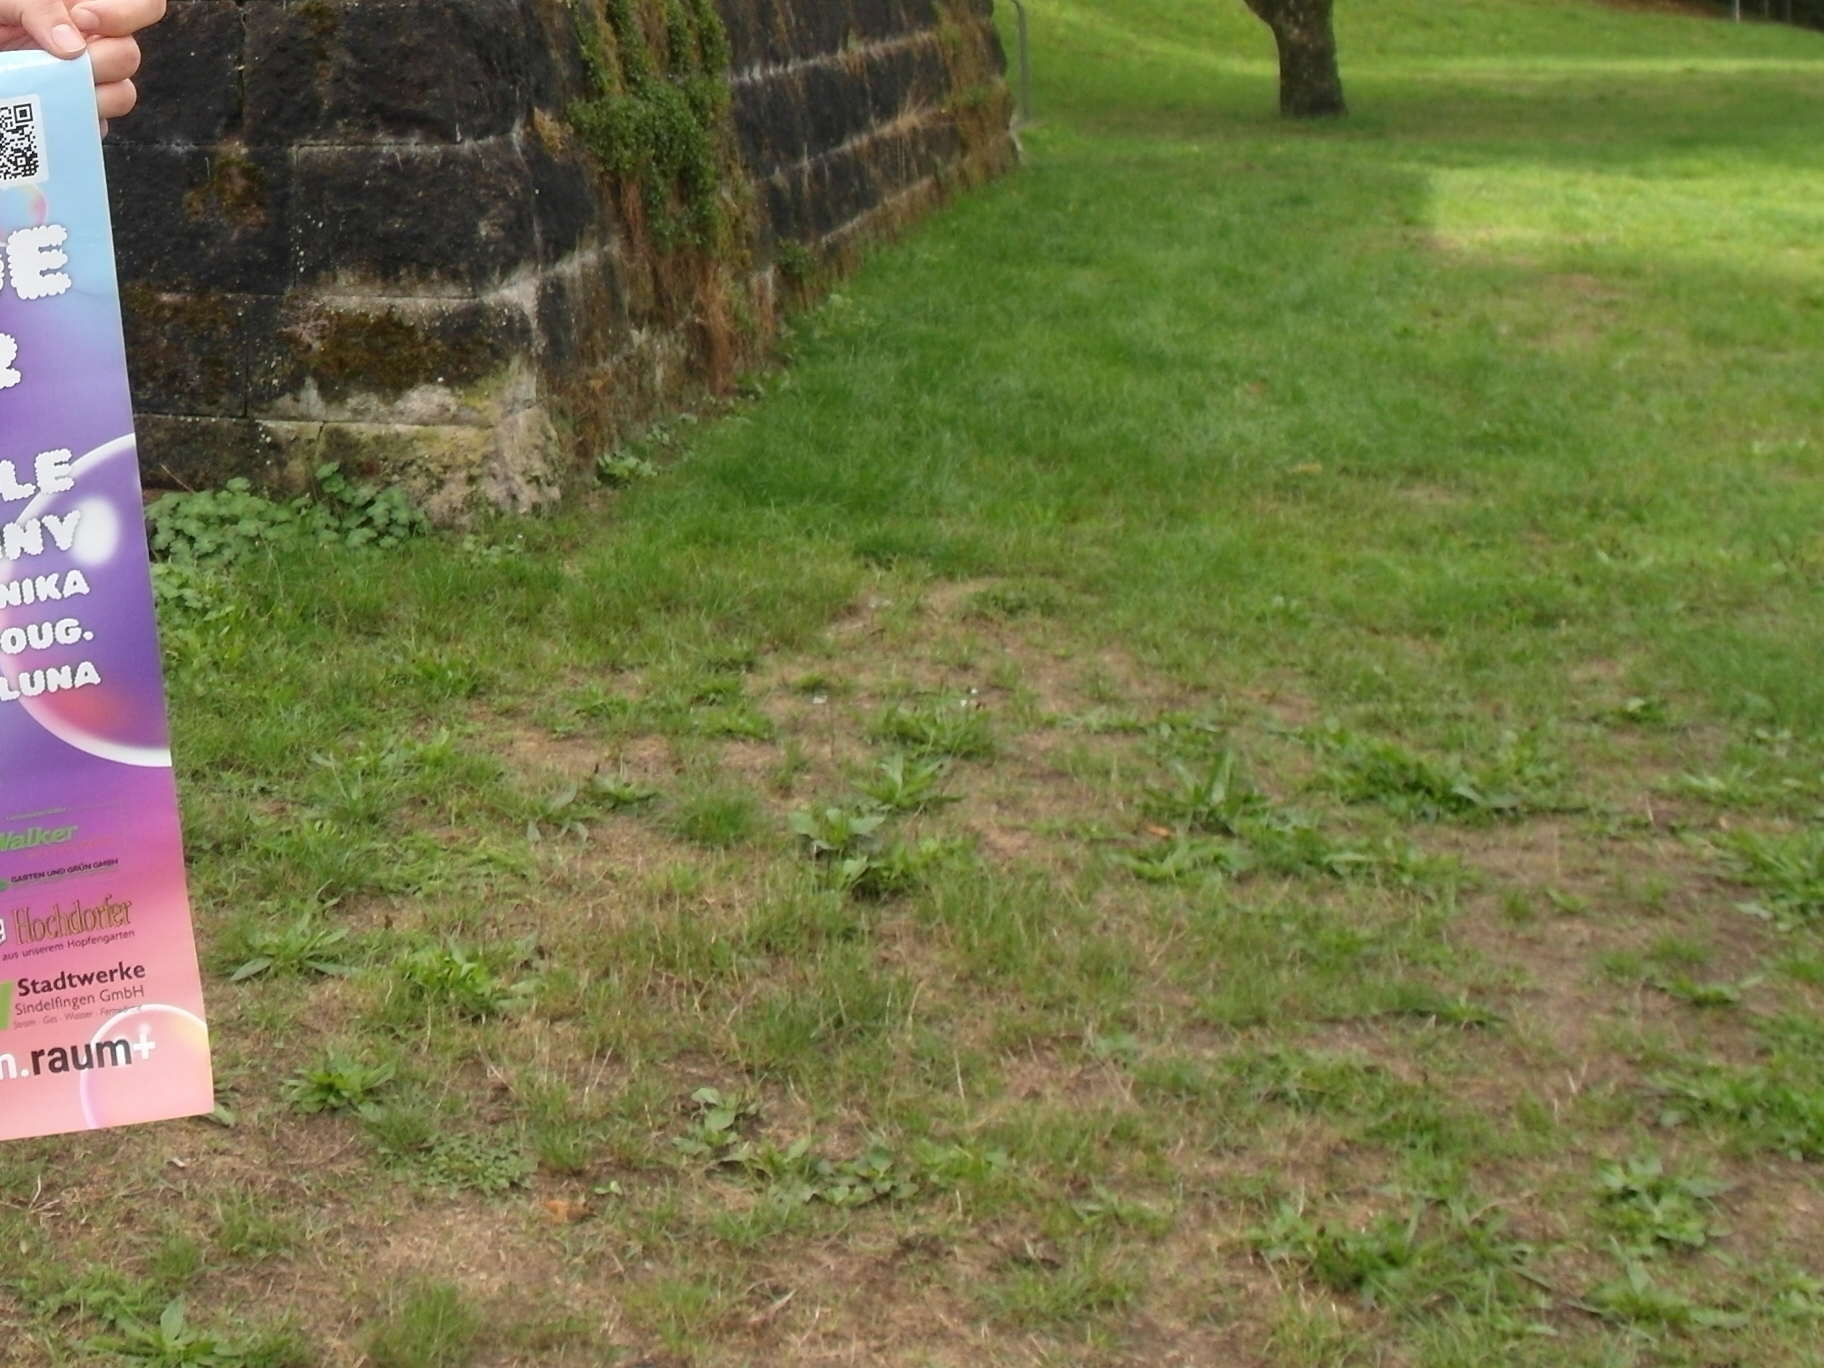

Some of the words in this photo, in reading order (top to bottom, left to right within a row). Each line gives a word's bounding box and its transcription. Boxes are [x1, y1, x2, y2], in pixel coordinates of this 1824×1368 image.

[11, 872, 46, 883] GARTEN
[46, 867, 66, 878] UND
[67, 862, 92, 874] GRÜN
[93, 858, 119, 870] GMBH
[11, 894, 133, 946] Hochdorfer
[2, 951, 19, 962] aus
[22, 943, 64, 957] unserem
[67, 930, 135, 949] Hopfengarten
[17, 961, 146, 997] Stadtwerke
[14, 996, 95, 1016] Sindelfingen
[99, 984, 145, 1003] GmbH
